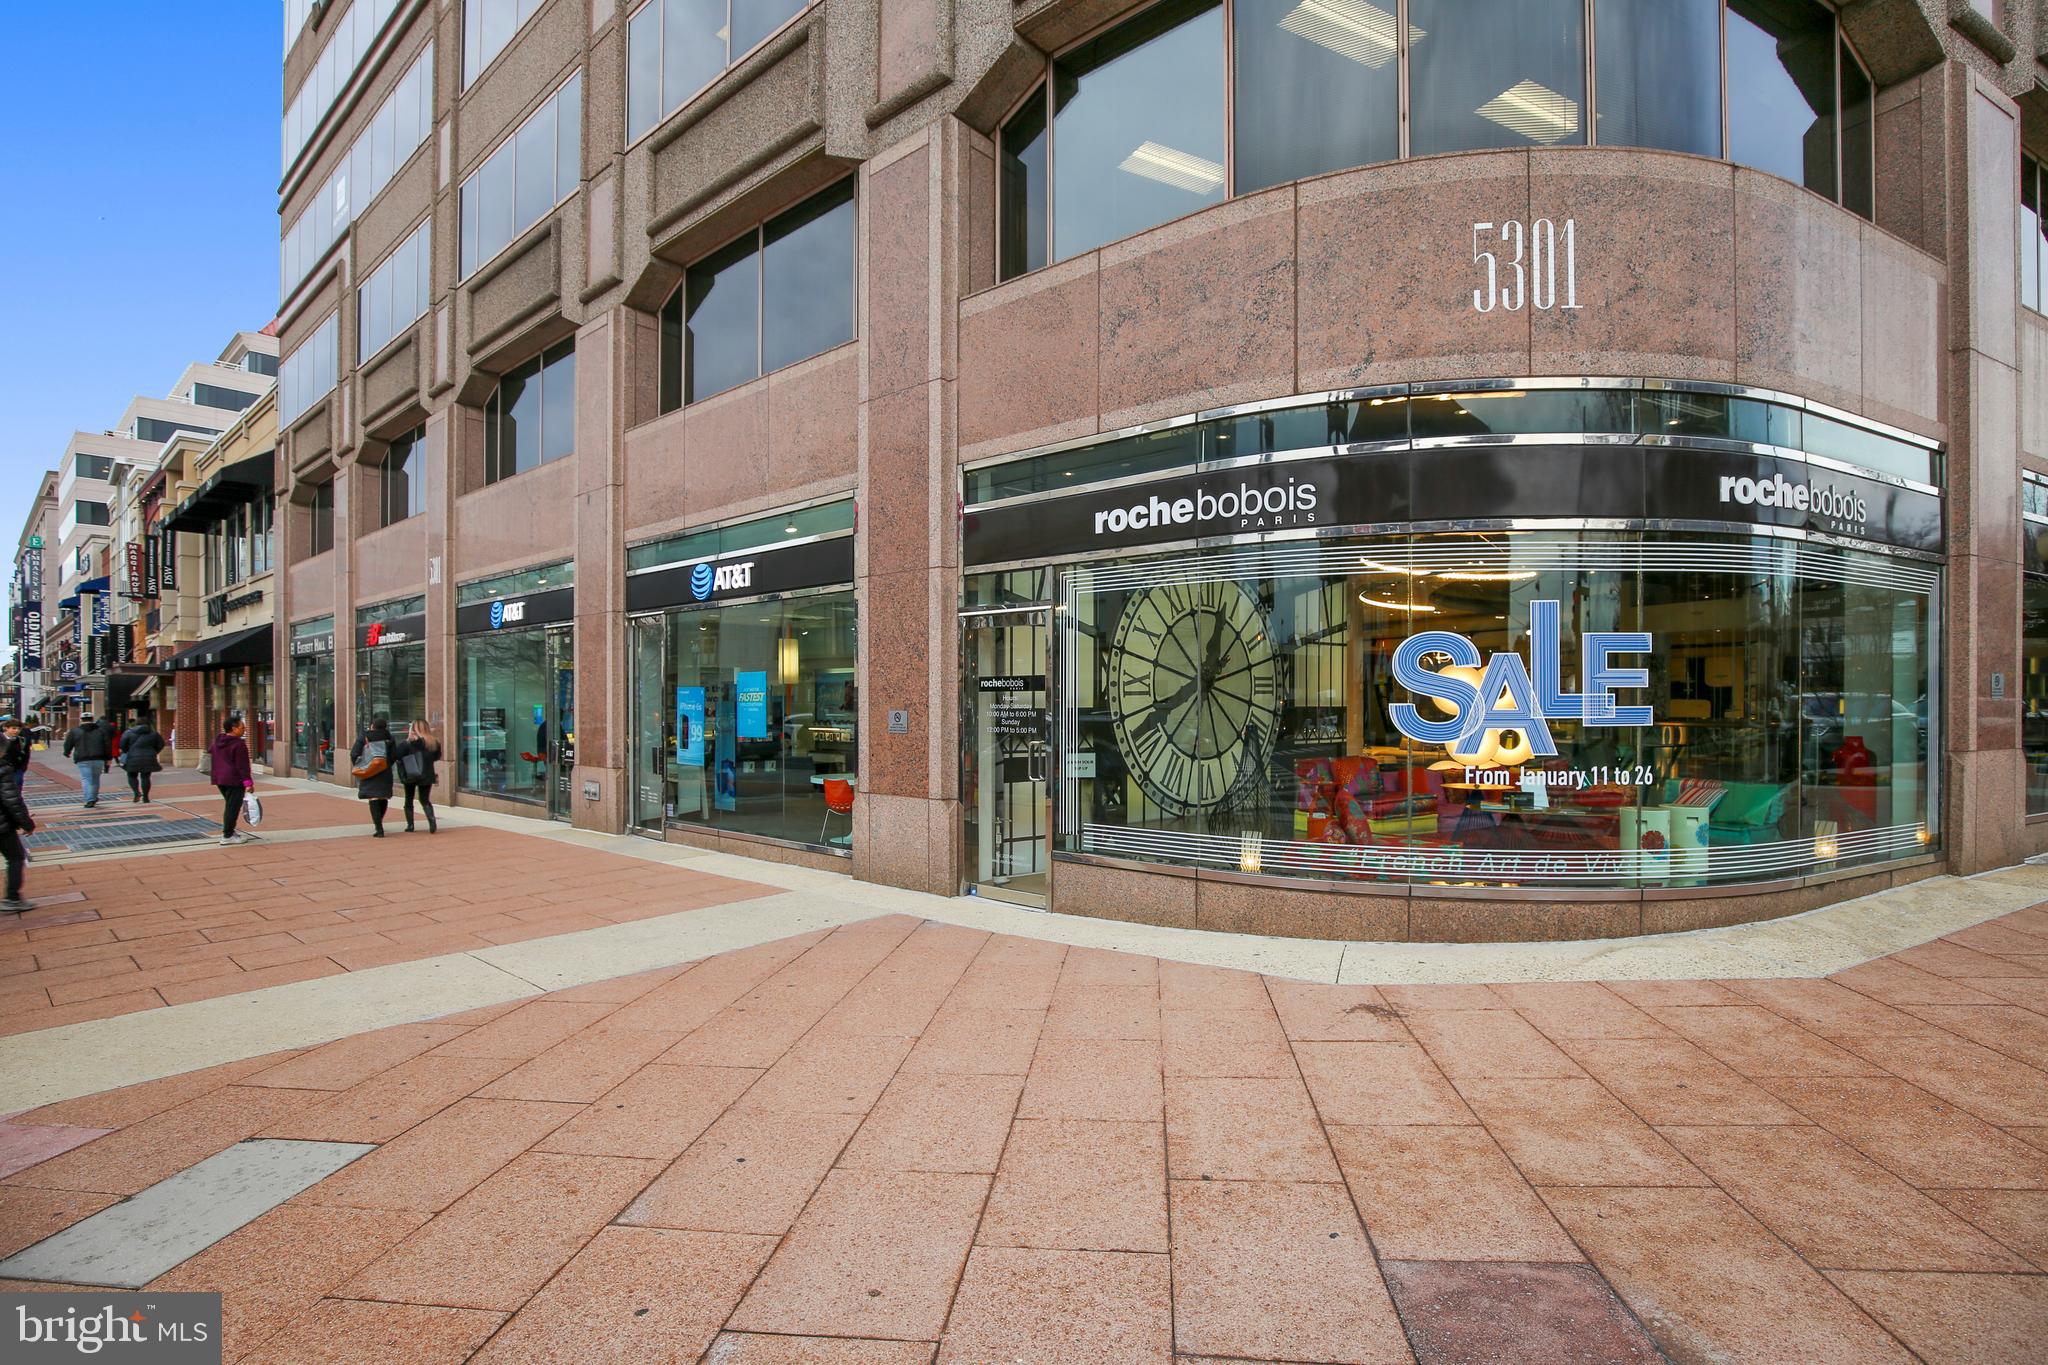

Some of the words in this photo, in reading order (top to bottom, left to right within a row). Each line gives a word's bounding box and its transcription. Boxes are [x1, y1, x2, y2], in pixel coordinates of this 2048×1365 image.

[1473, 218, 1583, 313] 5301
[1095, 477, 1317, 534] rochebobois
[1720, 474, 1867, 523] rochebobois
[1241, 512, 1315, 528] PARIS
[1831, 520, 1865, 535] PARIS
[164, 566, 173, 585] DSW
[713, 562, 754, 591] AT&T
[148, 577, 157, 594] DSW
[28, 611, 41, 630] OLD
[502, 602, 526, 622] AT&T
[28, 632, 41, 657] NAVY
[980, 678, 1024, 687] rochebobois
[1389, 600, 1653, 756] SALE
[739, 692, 766, 702] FASTEST
[1001, 718, 1021, 726] Sunday
[1465, 765, 1510, 785] From
[1515, 766, 1588, 790] January
[1591, 767, 1610, 786] 11
[1614, 768, 1630, 785] to
[1635, 766, 1653, 785] 26
[1478, 854, 1521, 873] Art
[1535, 855, 1567, 873] de
